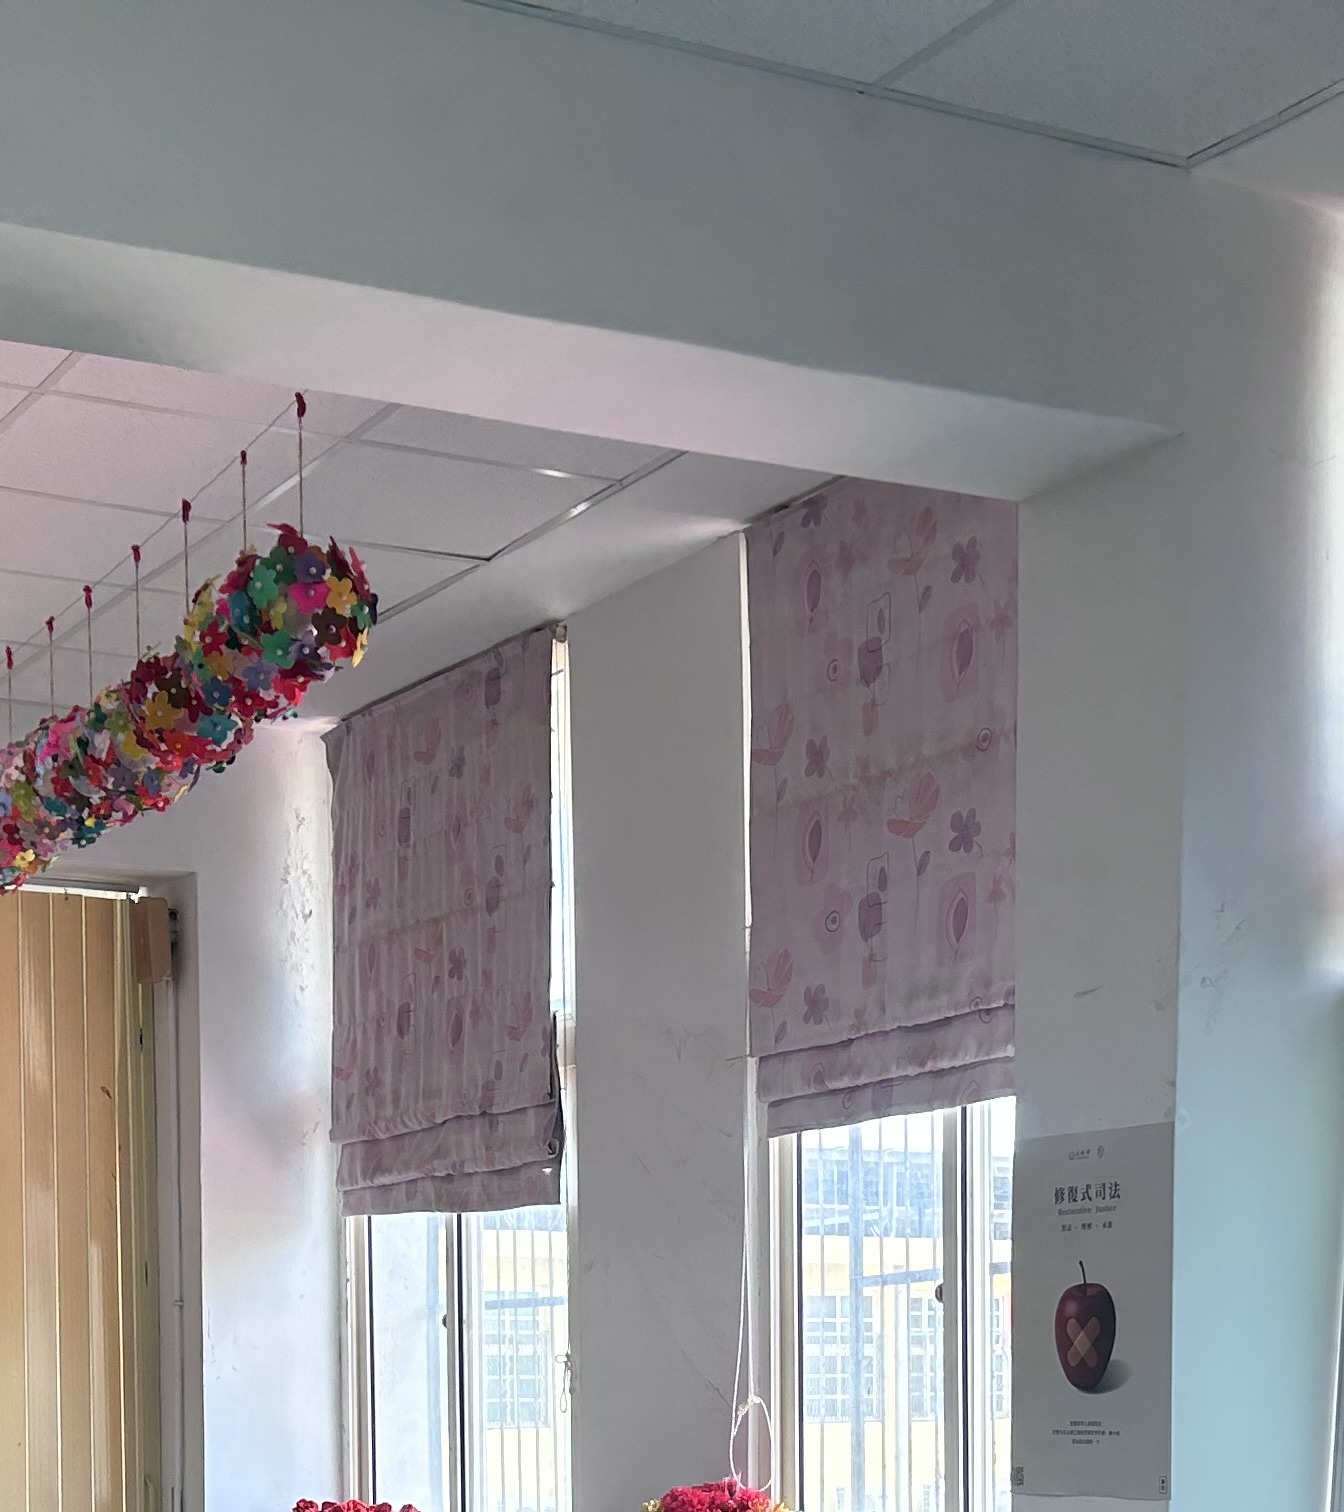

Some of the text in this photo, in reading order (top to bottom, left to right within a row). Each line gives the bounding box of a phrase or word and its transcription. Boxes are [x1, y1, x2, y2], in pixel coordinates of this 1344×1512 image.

[1053, 1181, 1121, 1205] 修復式司法
